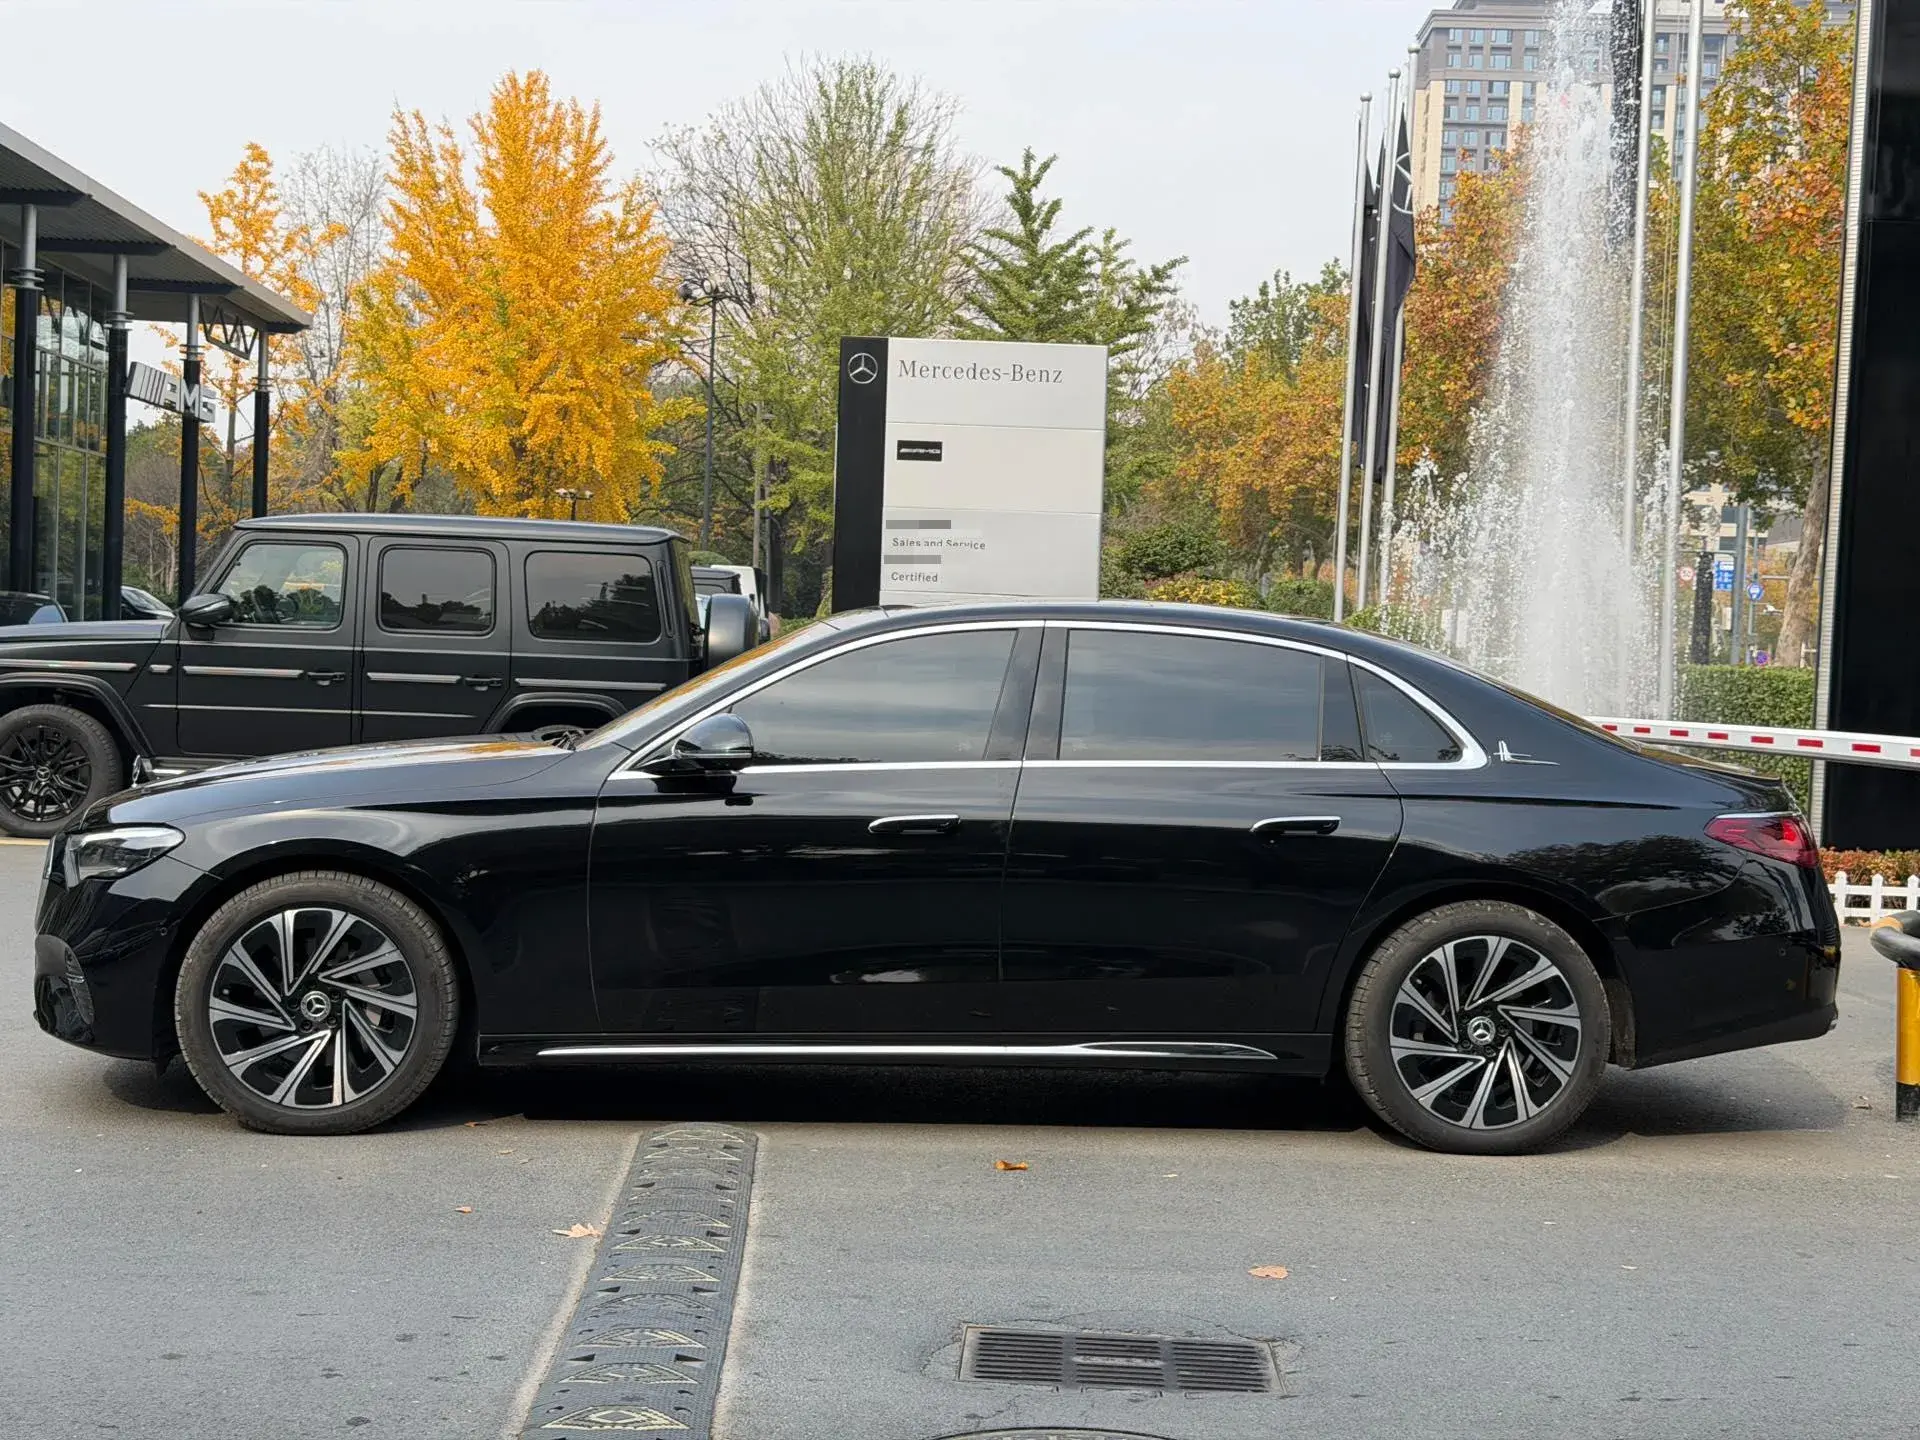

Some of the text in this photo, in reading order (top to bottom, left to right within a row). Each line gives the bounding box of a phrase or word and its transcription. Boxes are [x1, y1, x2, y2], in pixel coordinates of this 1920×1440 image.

[898, 360, 1063, 383] Mercedes-Benz
[158, 374, 216, 423] AMG
[892, 537, 986, 549] Sales and Service
[891, 571, 938, 582] Certified
